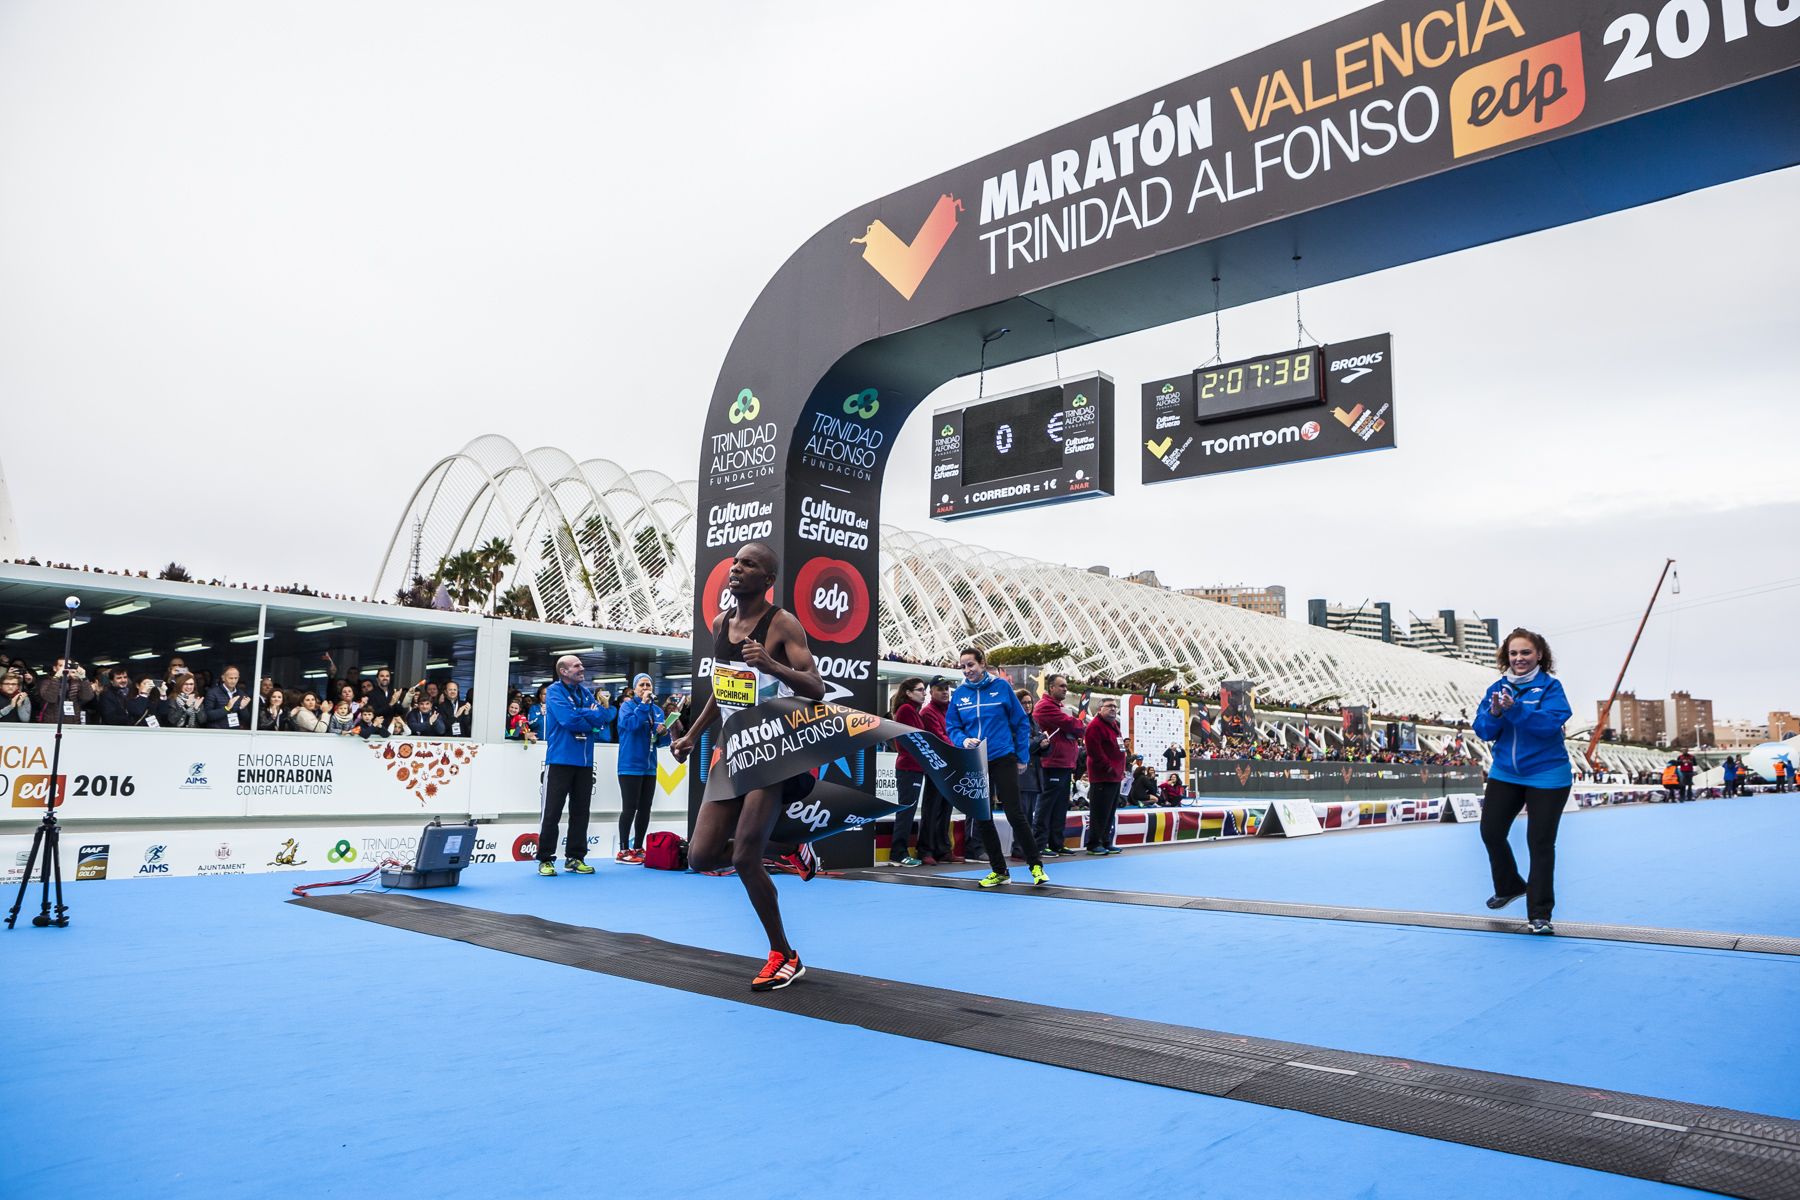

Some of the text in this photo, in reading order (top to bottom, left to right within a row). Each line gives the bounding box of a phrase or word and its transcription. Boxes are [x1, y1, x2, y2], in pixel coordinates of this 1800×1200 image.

[1467, 59, 1568, 127] edp
[979, 0, 1526, 226] MARATÓN VALENCIA
[979, 85, 1440, 275] TRINIDAD ALFONSO
[1330, 351, 1384, 372] BROOKS
[1201, 354, 1311, 400] 2:07:38
[1064, 405, 1095, 419] TRINIDAD
[1064, 412, 1095, 425] ALFONSO
[711, 423, 777, 454] TRINIDAD
[811, 412, 883, 449] TRINIDAD
[935, 435, 961, 447] TRINIDAD
[996, 424, 1013, 454] 0
[804, 435, 876, 468] ALFONSO
[934, 442, 961, 453] ALFONSO
[1064, 443, 1095, 454] Esfuerzo
[1065, 437, 1088, 447] Cultura
[710, 444, 776, 474] ALFONSO
[802, 456, 872, 481] FUNDACIÓN
[709, 466, 775, 486] FUNDACIÓN
[933, 469, 959, 480] Esfuerzo
[964, 494, 970, 504] 1
[972, 484, 1031, 503] CORREDOR
[1043, 479, 1057, 491] 1€
[1069, 482, 1089, 491] ANAR
[708, 501, 773, 525] Cultura del
[801, 496, 869, 529] Cultura del
[936, 505, 954, 513] ANAR
[706, 520, 772, 547] Esfuerzo
[799, 518, 869, 551] Esfuerzo
[814, 583, 849, 619] edp
[727, 680, 735, 688] 11
[781, 716, 845, 756] ALFONSO
[238, 754, 334, 767] ENHORABUENA
[72, 775, 135, 796] 2016
[237, 769, 333, 783] ENHORABONA
[236, 784, 333, 795] CONGRATULATIONS
[786, 800, 831, 832] edp
[81, 846, 104, 854] IAAF
[362, 838, 417, 851] TRINIDAD
[485, 842, 497, 850] del
[139, 864, 169, 874] AIMS
[198, 863, 247, 871] AJUNTAMENT
